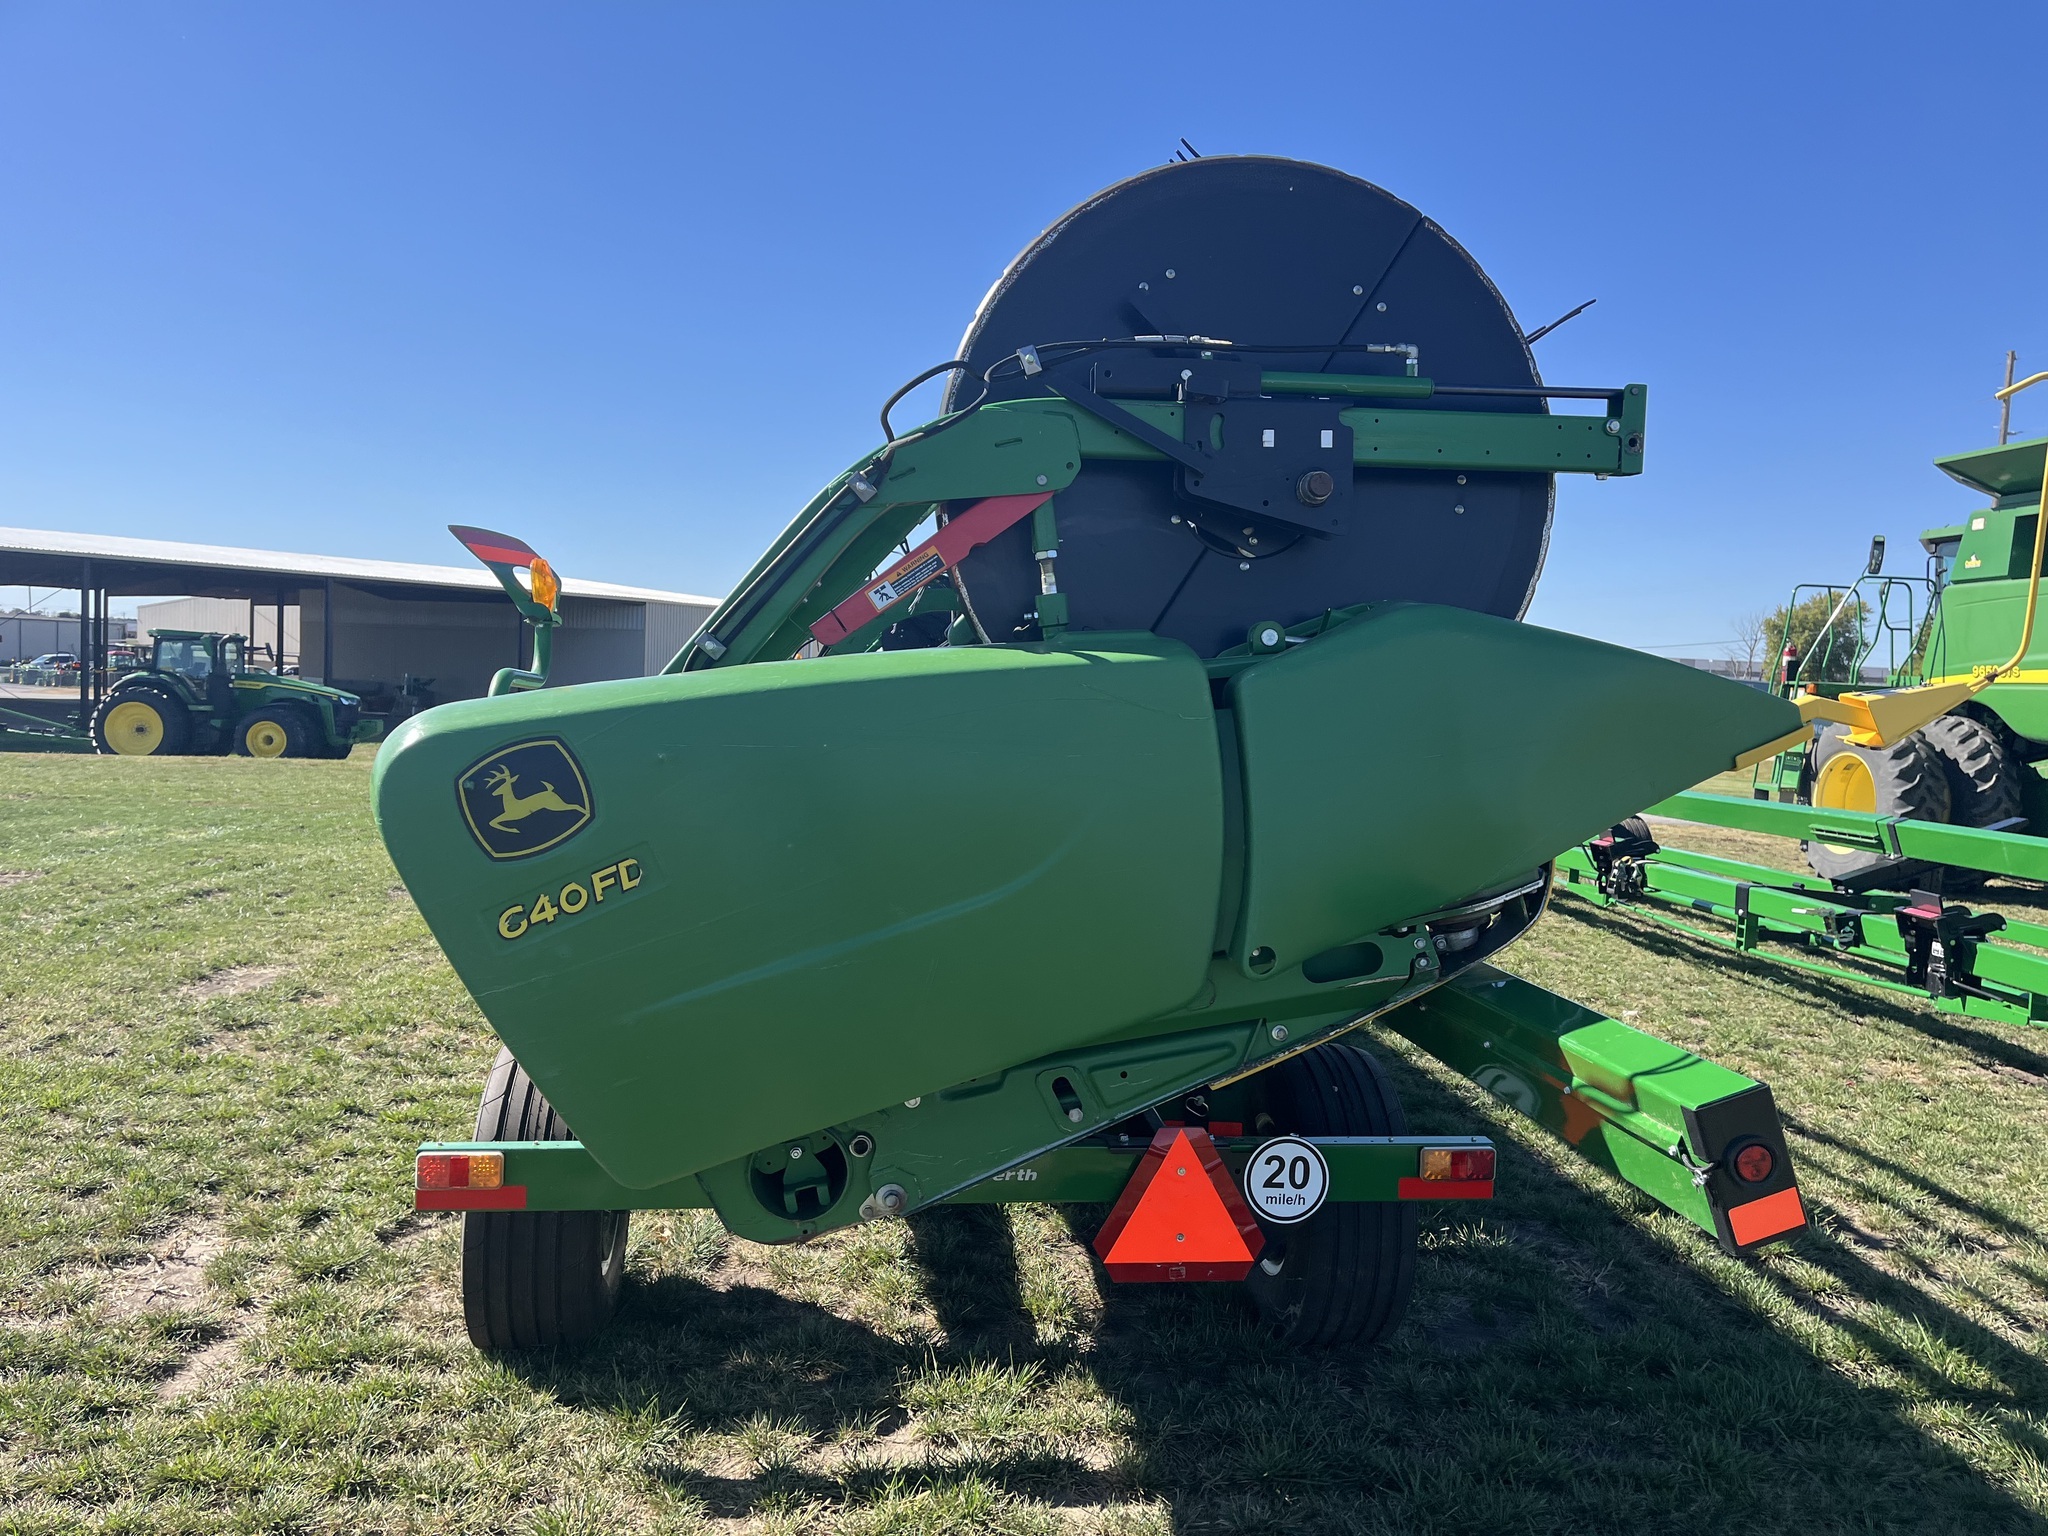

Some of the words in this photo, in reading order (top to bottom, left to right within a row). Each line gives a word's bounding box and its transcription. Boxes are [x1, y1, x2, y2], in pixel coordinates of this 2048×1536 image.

[902, 552, 930, 573] WARNING
[1262, 1155, 1311, 1190] 20
[1265, 1193, 1306, 1206] mile/h
